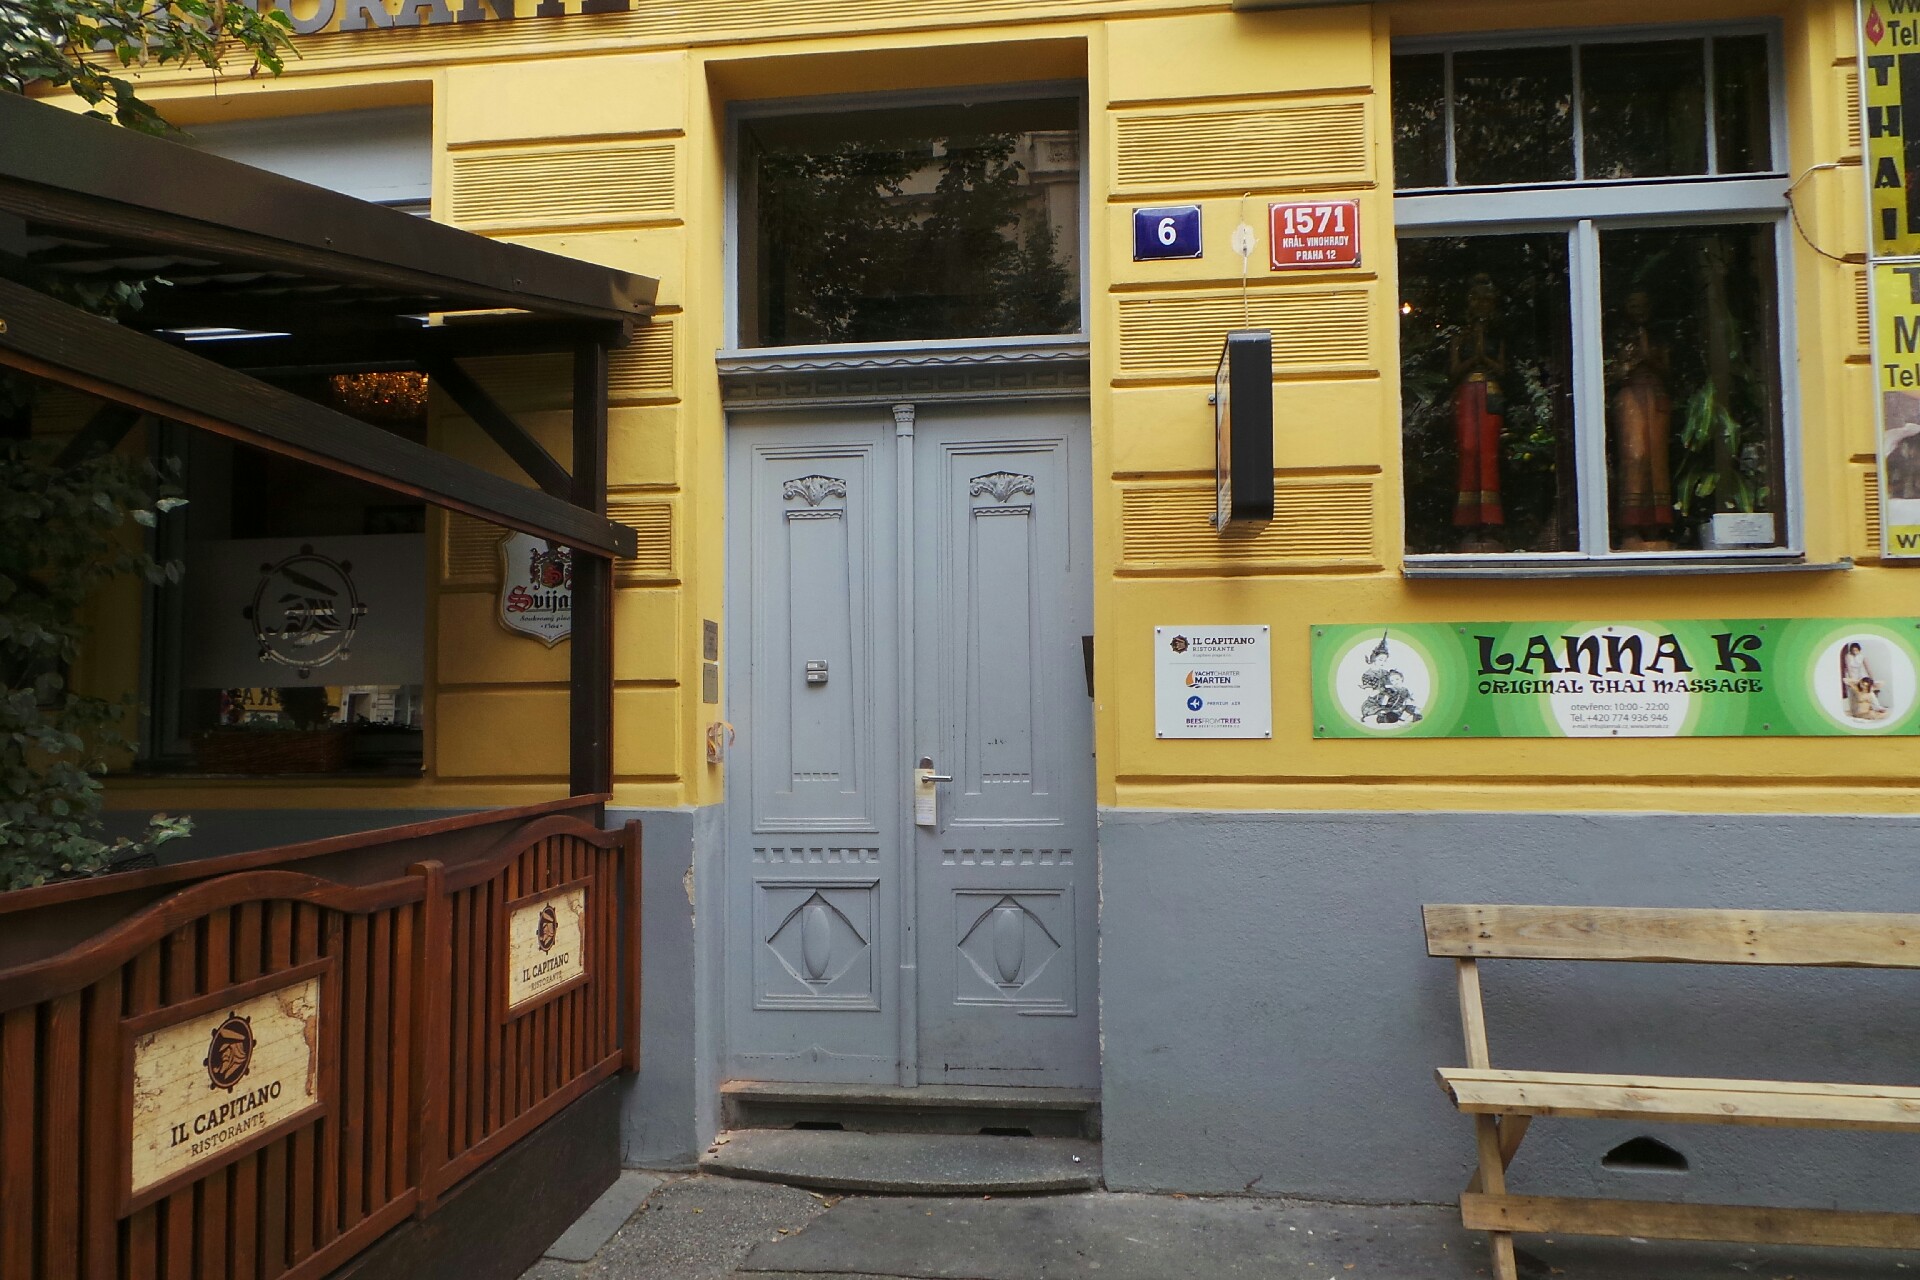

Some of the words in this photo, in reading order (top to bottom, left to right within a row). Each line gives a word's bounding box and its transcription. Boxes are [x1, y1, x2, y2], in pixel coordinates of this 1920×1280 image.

[1867, 54, 1902, 240] THAI
[1157, 217, 1177, 246] 6
[1283, 206, 1346, 234] 1571
[1306, 235, 1350, 247] VINOHRADY
[1296, 251, 1324, 261] PRAHA
[1326, 250, 1337, 260] 12
[1192, 637, 1203, 645] IL
[1204, 637, 1255, 645] CAPITANO
[1711, 633, 1763, 674] K
[1477, 679, 1584, 695] ORIGINAL
[1590, 679, 1646, 694] THAI
[1652, 678, 1764, 694] MASSAGE
[1570, 713, 1586, 722] Tel.
[1586, 713, 1610, 722] +420
[1612, 713, 1629, 722] 774
[1631, 713, 1649, 722] 936
[1650, 713, 1668, 722] 946
[1571, 703, 1612, 711] otevřeno:
[1615, 702, 1638, 711] 10:00
[1645, 702, 1670, 711] 22:00
[523, 969, 531, 982] IL
[532, 953, 569, 978] CAPITANO
[170, 1122, 190, 1148] IL
[193, 1080, 282, 1135] CAPITANO
[191, 1111, 266, 1157] RISTORANTE
